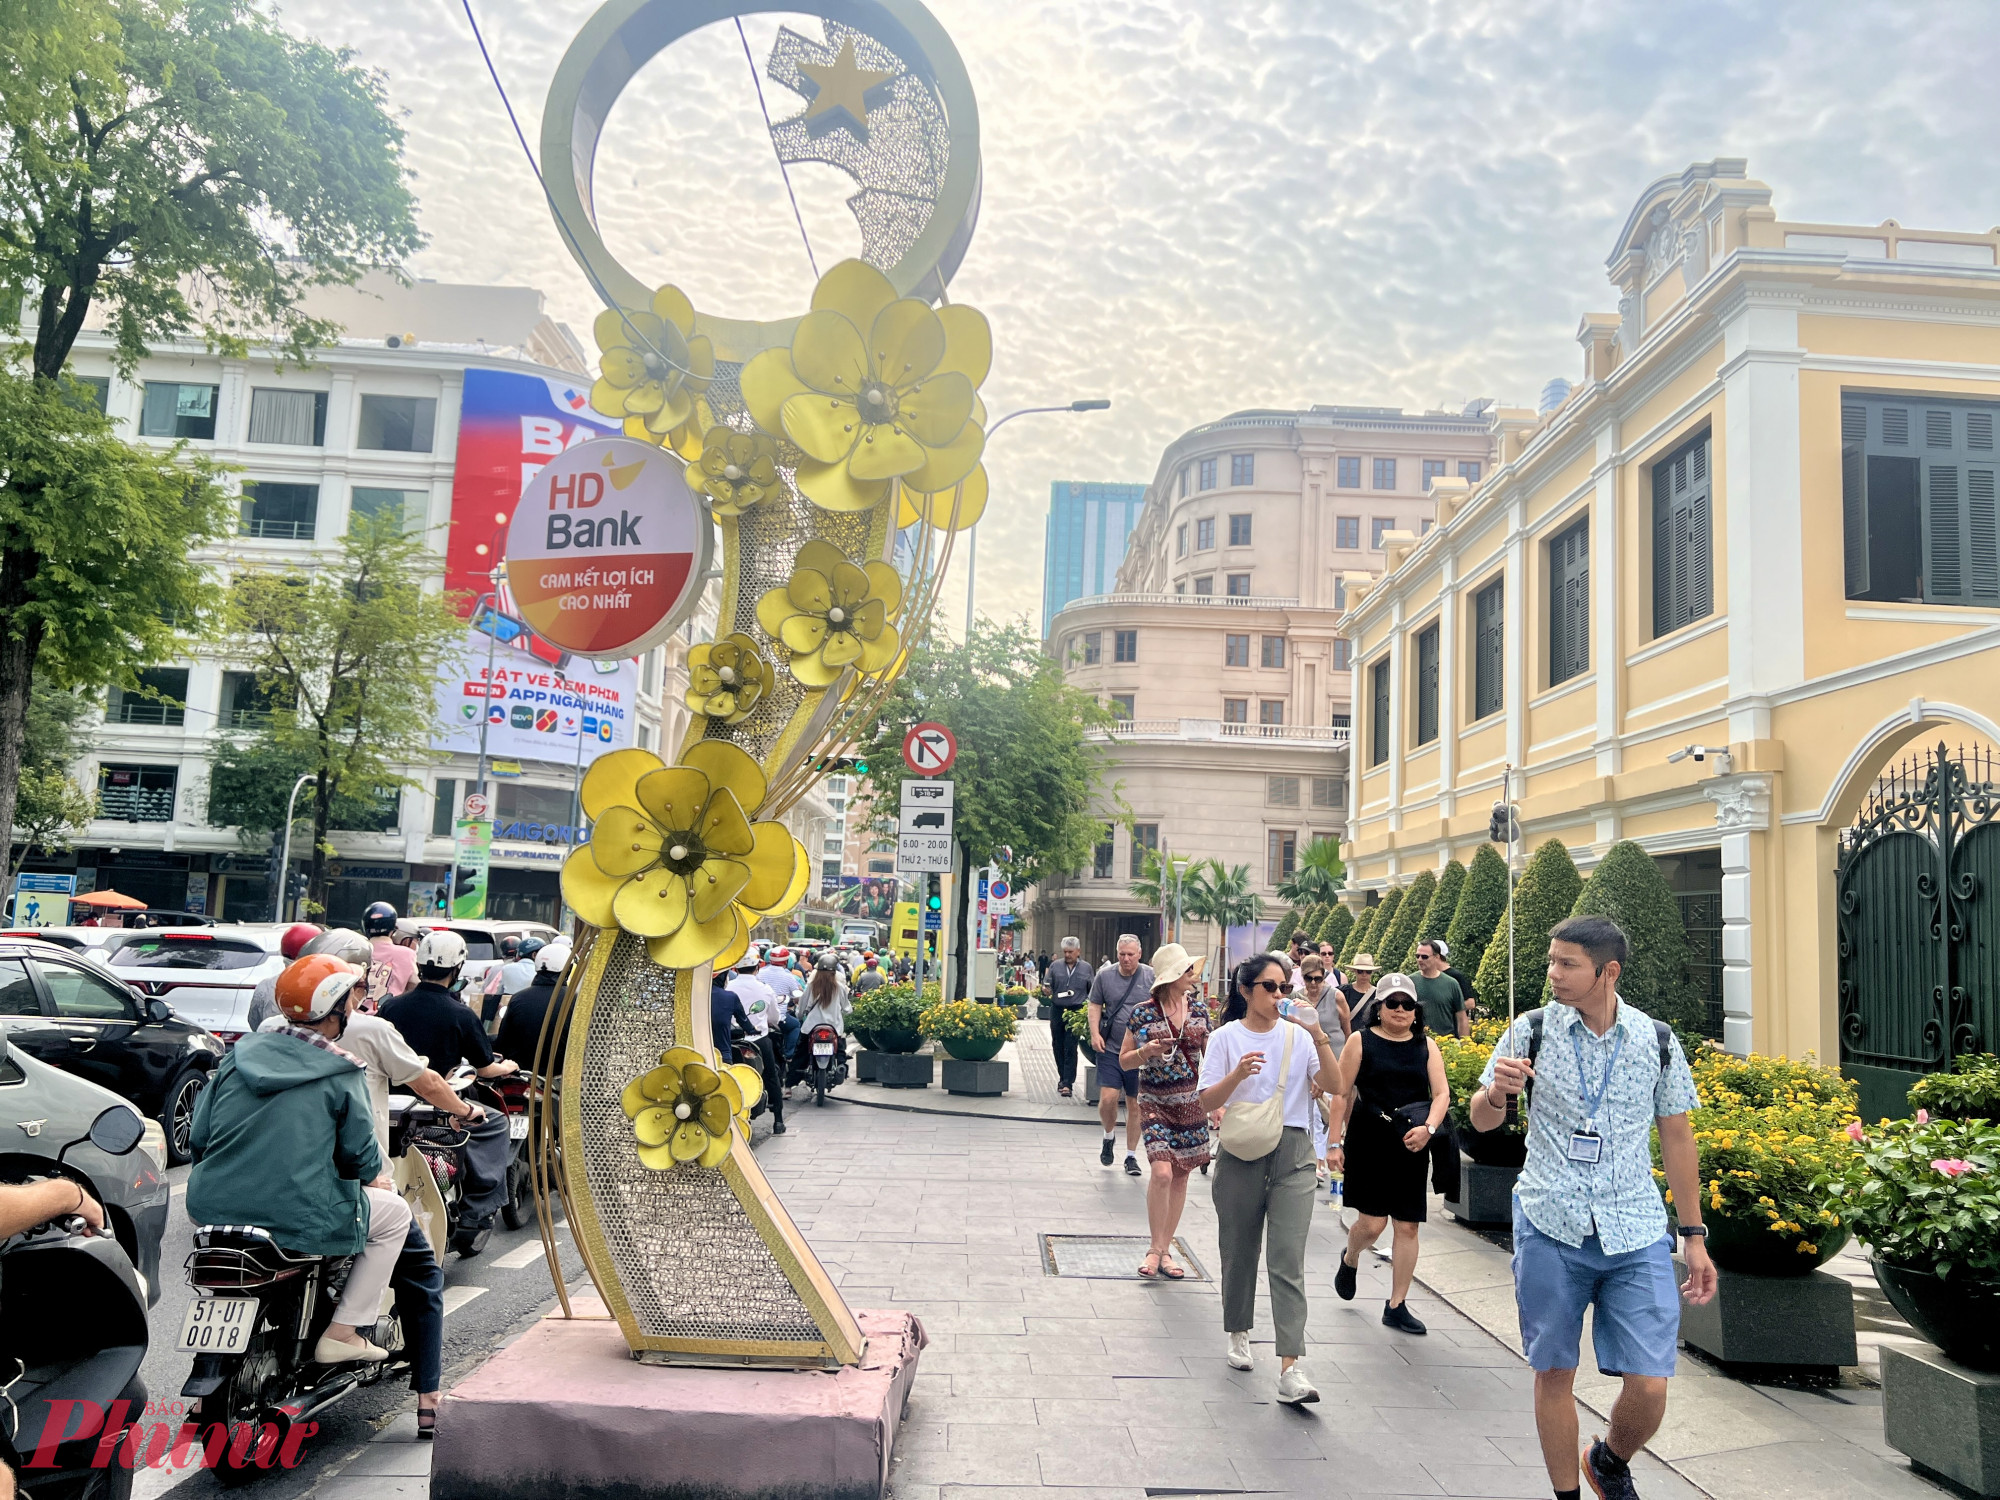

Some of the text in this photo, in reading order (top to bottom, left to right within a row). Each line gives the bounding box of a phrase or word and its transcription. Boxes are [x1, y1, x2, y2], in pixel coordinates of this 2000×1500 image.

[549, 472, 605, 511] HD
[546, 510, 643, 550] Bank
[539, 573, 571, 589] CAM
[574, 566, 600, 587] KẾT
[630, 566, 654, 585] ÍCH
[558, 588, 632, 611] CAO NHẤT
[508, 687, 547, 703] APP
[552, 676, 586, 694] XEM
[588, 684, 620, 703] PHIM
[503, 849, 560, 861] INFORMATION
[901, 853, 916, 864] THỨ
[916, 855, 922, 865] 2
[928, 854, 943, 865] THỨ
[943, 856, 949, 865] 6
[193, 1300, 246, 1323] 51-U1
[186, 1325, 240, 1348] 0018
